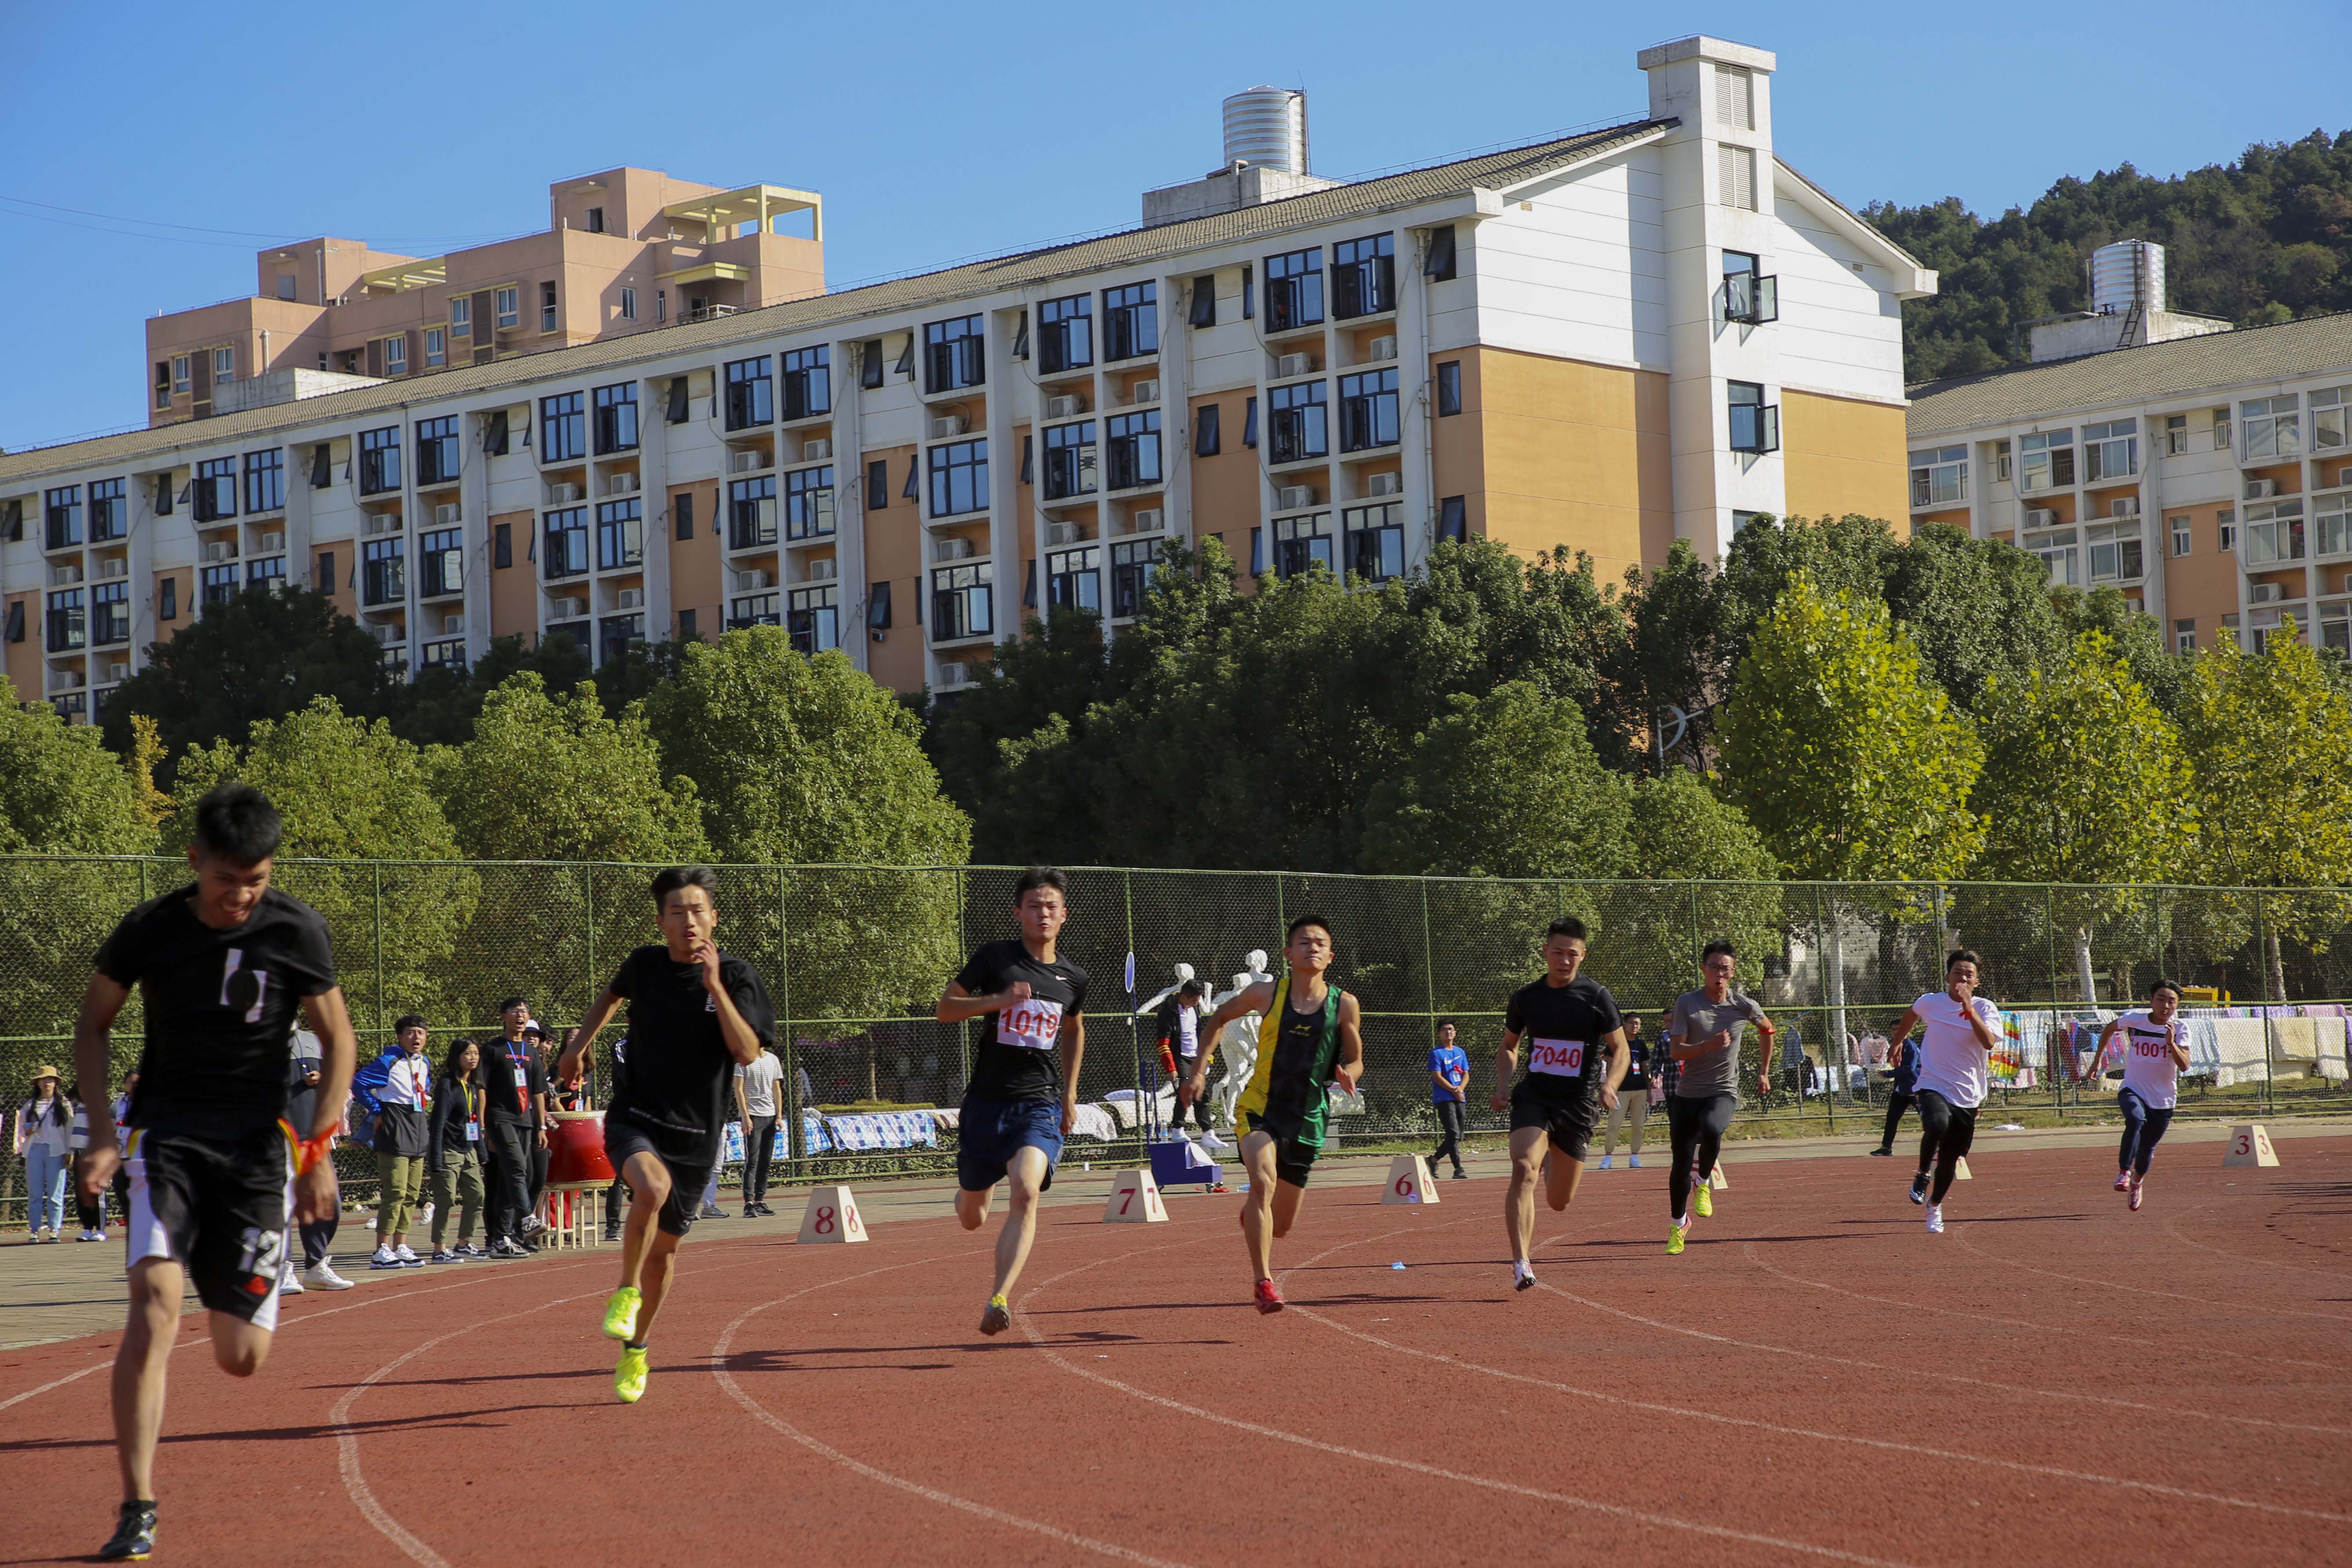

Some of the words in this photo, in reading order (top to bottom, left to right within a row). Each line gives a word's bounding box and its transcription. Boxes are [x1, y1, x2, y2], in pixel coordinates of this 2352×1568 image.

[1001, 1008, 1058, 1039] 1019
[1534, 1045, 1581, 1068] 7040
[2134, 1041, 2167, 1058] 1001
[2235, 1135, 2250, 1155] 3
[2258, 1134, 2269, 1155] 3
[1395, 1172, 1413, 1195] 6
[1423, 1171, 1432, 1195] 6
[1118, 1188, 1136, 1215] 7
[815, 1206, 834, 1234] 8
[845, 1205, 858, 1232] 8
[238, 1227, 282, 1280] 12
